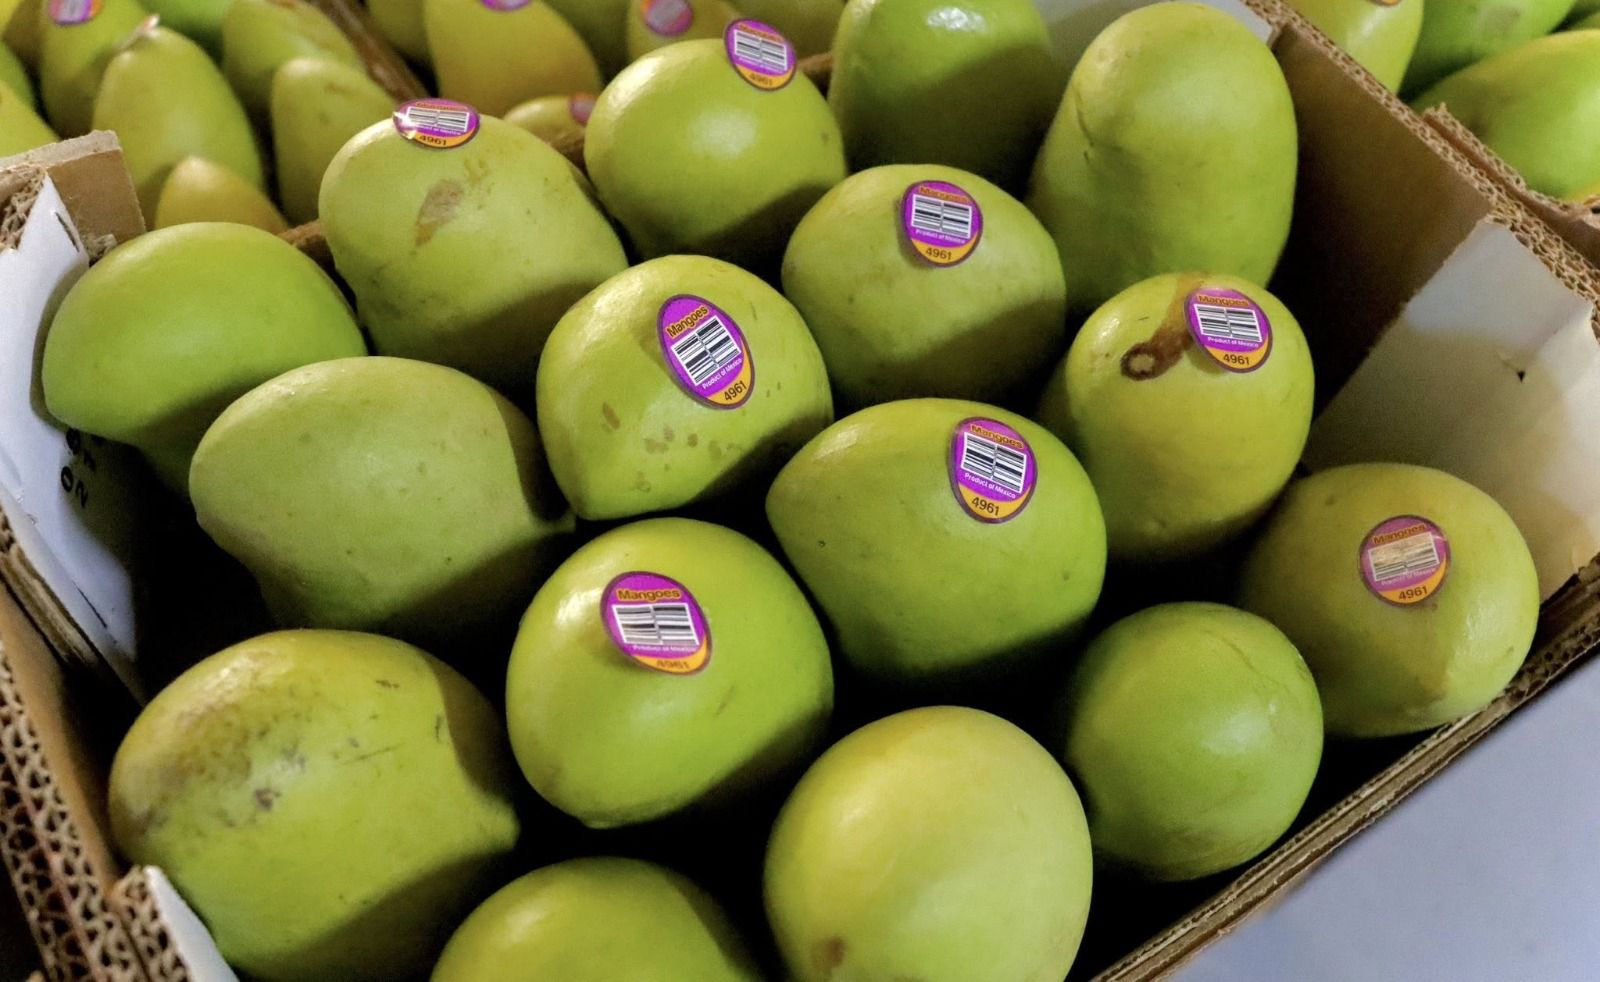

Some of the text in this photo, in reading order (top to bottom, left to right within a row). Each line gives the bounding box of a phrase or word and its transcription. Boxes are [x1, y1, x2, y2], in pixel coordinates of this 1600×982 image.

[418, 135, 447, 146] 4961
[925, 247, 952, 260] 4961
[665, 304, 710, 339] Mangoes
[1223, 353, 1250, 366] 4961
[702, 372, 722, 389] Product
[723, 380, 747, 401] 4961
[970, 424, 1025, 450] Mangoes
[964, 472, 988, 488] Product
[995, 485, 1016, 499] Mexico
[971, 496, 1000, 516] 4961
[616, 588, 682, 603] Mangoes
[1398, 586, 1428, 600] 4961
